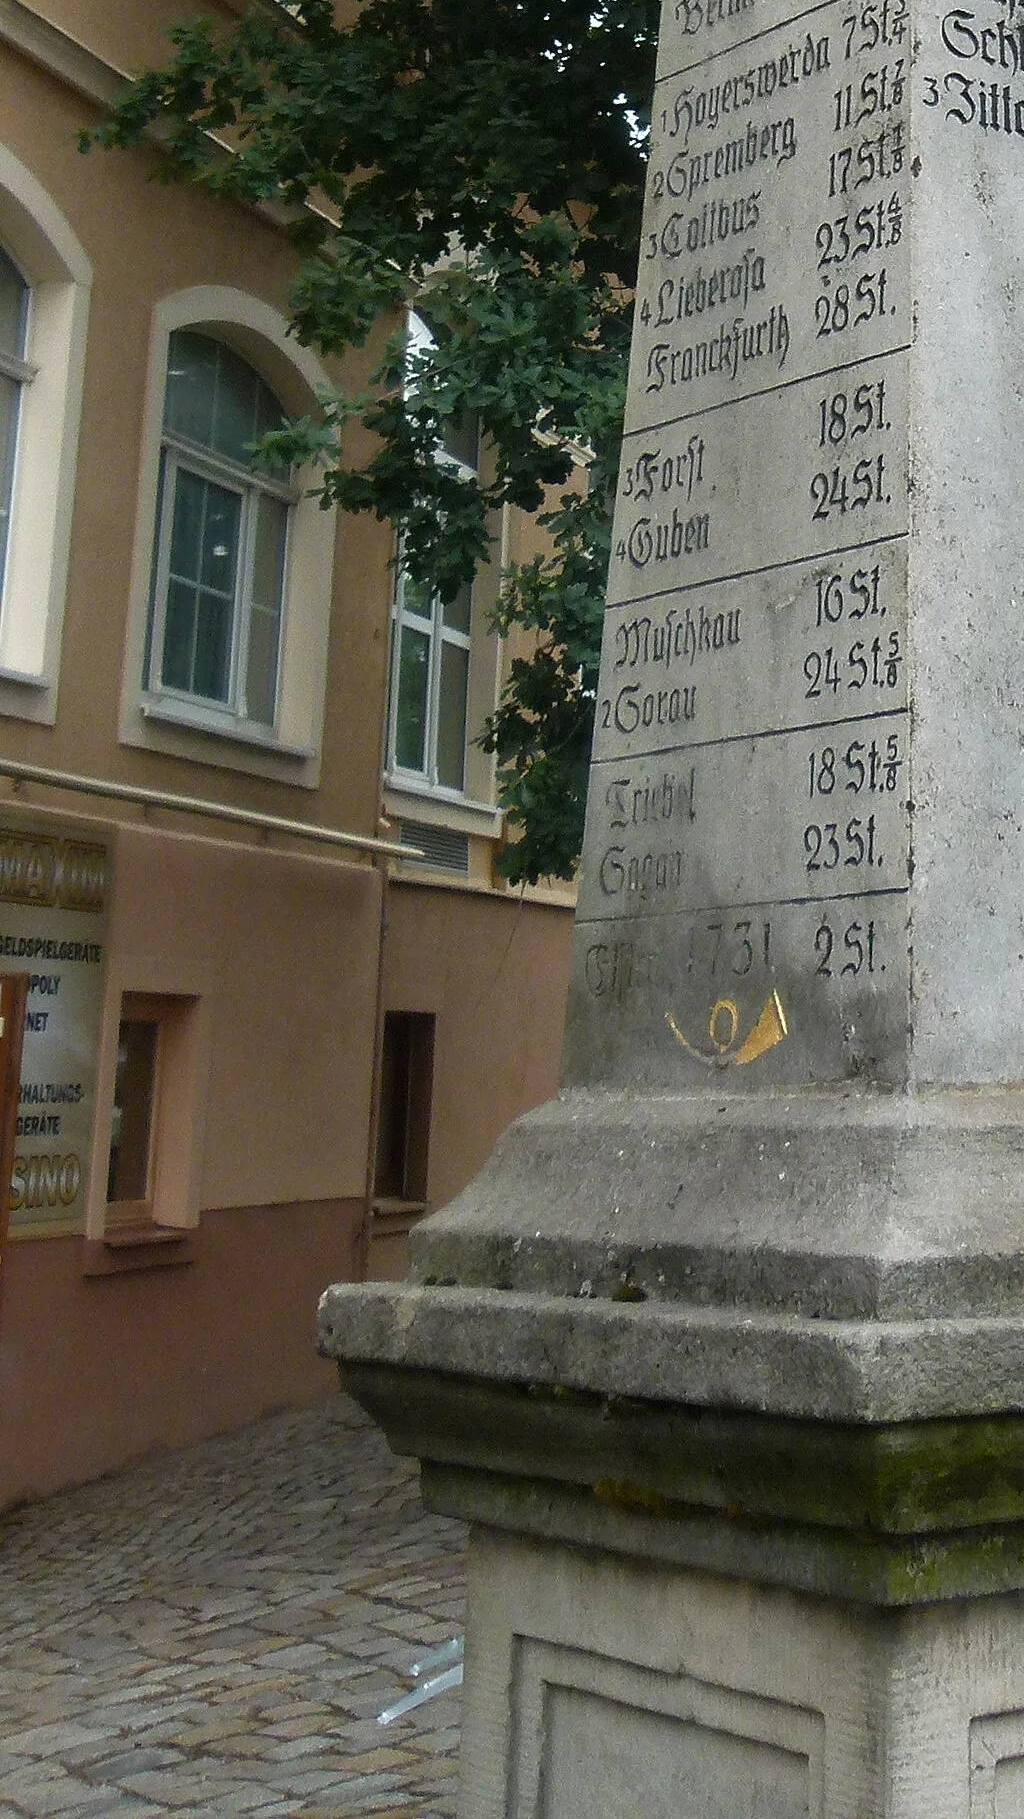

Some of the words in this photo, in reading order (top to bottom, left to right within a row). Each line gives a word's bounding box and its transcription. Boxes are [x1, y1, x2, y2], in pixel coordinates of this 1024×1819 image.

[842, 15, 857, 60] 7
[834, 84, 852, 132] 11
[923, 77, 939, 106] 3
[828, 147, 852, 197] 17
[815, 211, 850, 270] 23
[815, 281, 849, 339] 28
[854, 269, 896, 329] St.
[818, 393, 847, 447] 18
[851, 380, 891, 438] St.
[810, 467, 848, 521] 24
[850, 454, 891, 510] St.
[815, 575, 843, 627] 16
[849, 564, 886, 620] St.
[804, 647, 840, 700] 24
[808, 747, 836, 798] 18
[803, 822, 837, 872] 23
[845, 815, 882, 868] St.
[814, 924, 833, 977] 2
[840, 921, 886, 977] St.
